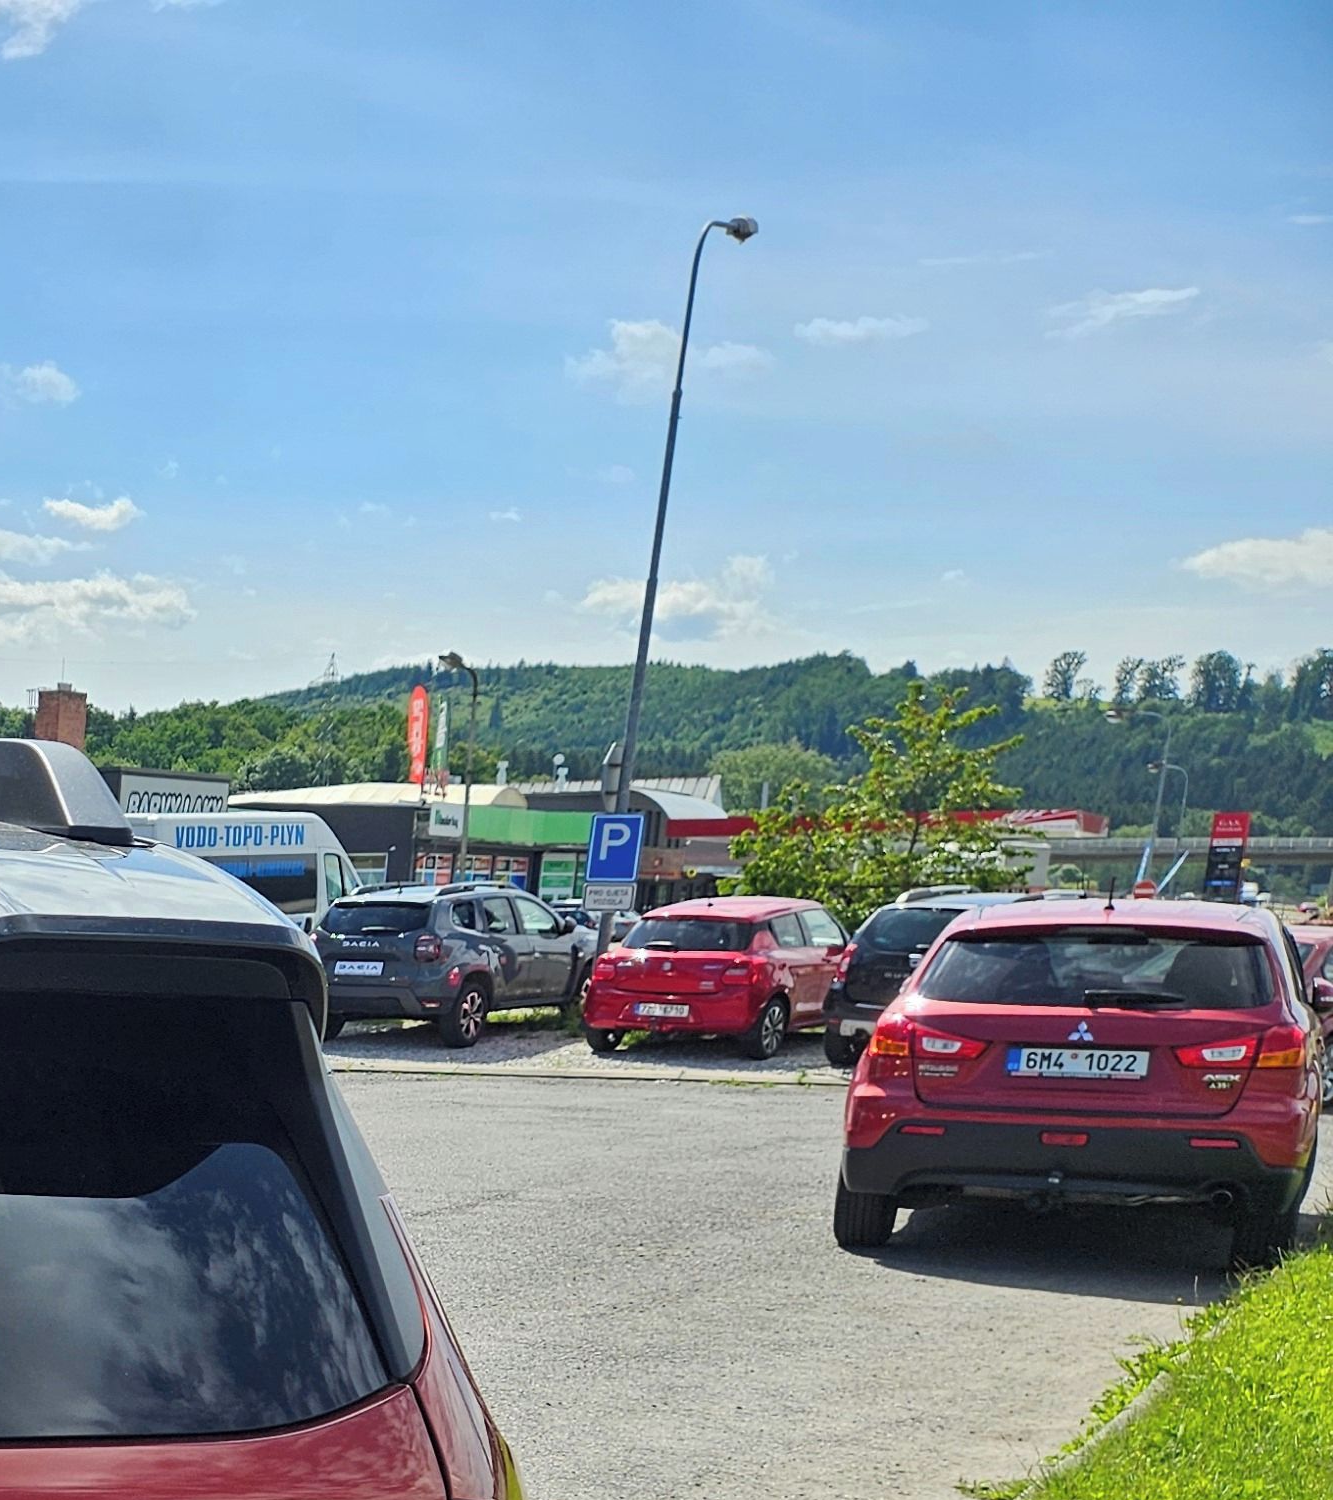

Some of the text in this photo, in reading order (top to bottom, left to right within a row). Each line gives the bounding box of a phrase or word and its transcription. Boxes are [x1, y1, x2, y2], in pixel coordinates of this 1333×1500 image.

[175, 824, 305, 848] VODO-TOPO-PLYN
[599, 822, 631, 861] P
[1026, 1051, 1064, 1070] 6M4
[1086, 1053, 1137, 1073] 1022
